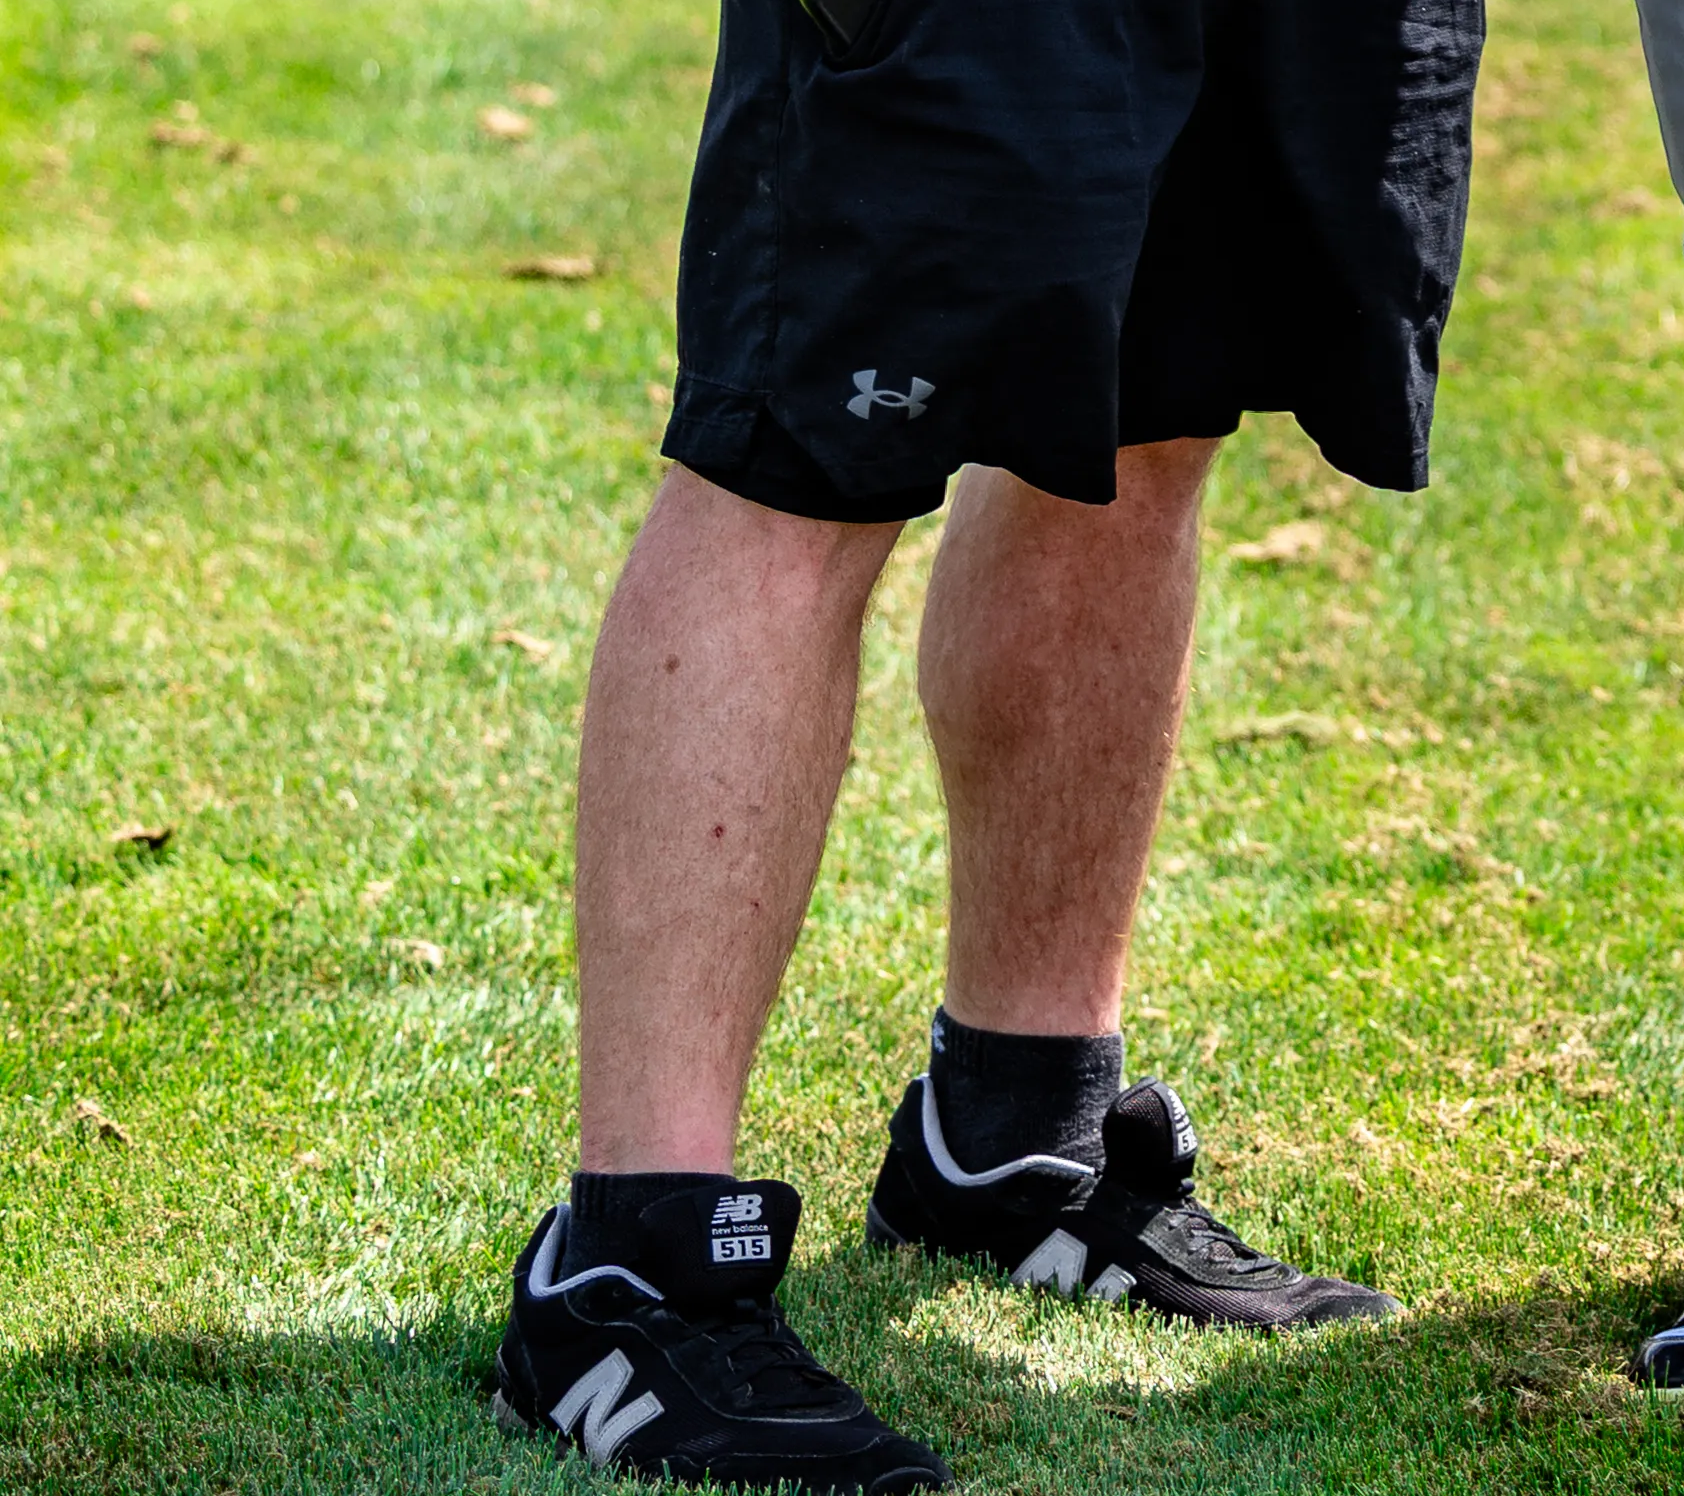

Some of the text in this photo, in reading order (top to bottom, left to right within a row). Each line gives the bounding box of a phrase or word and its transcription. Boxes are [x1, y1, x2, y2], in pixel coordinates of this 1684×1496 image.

[711, 1193, 763, 1225] NB
[711, 1223, 769, 1236] new balance
[720, 1238, 765, 1259] 515
[549, 1347, 665, 1469] N
